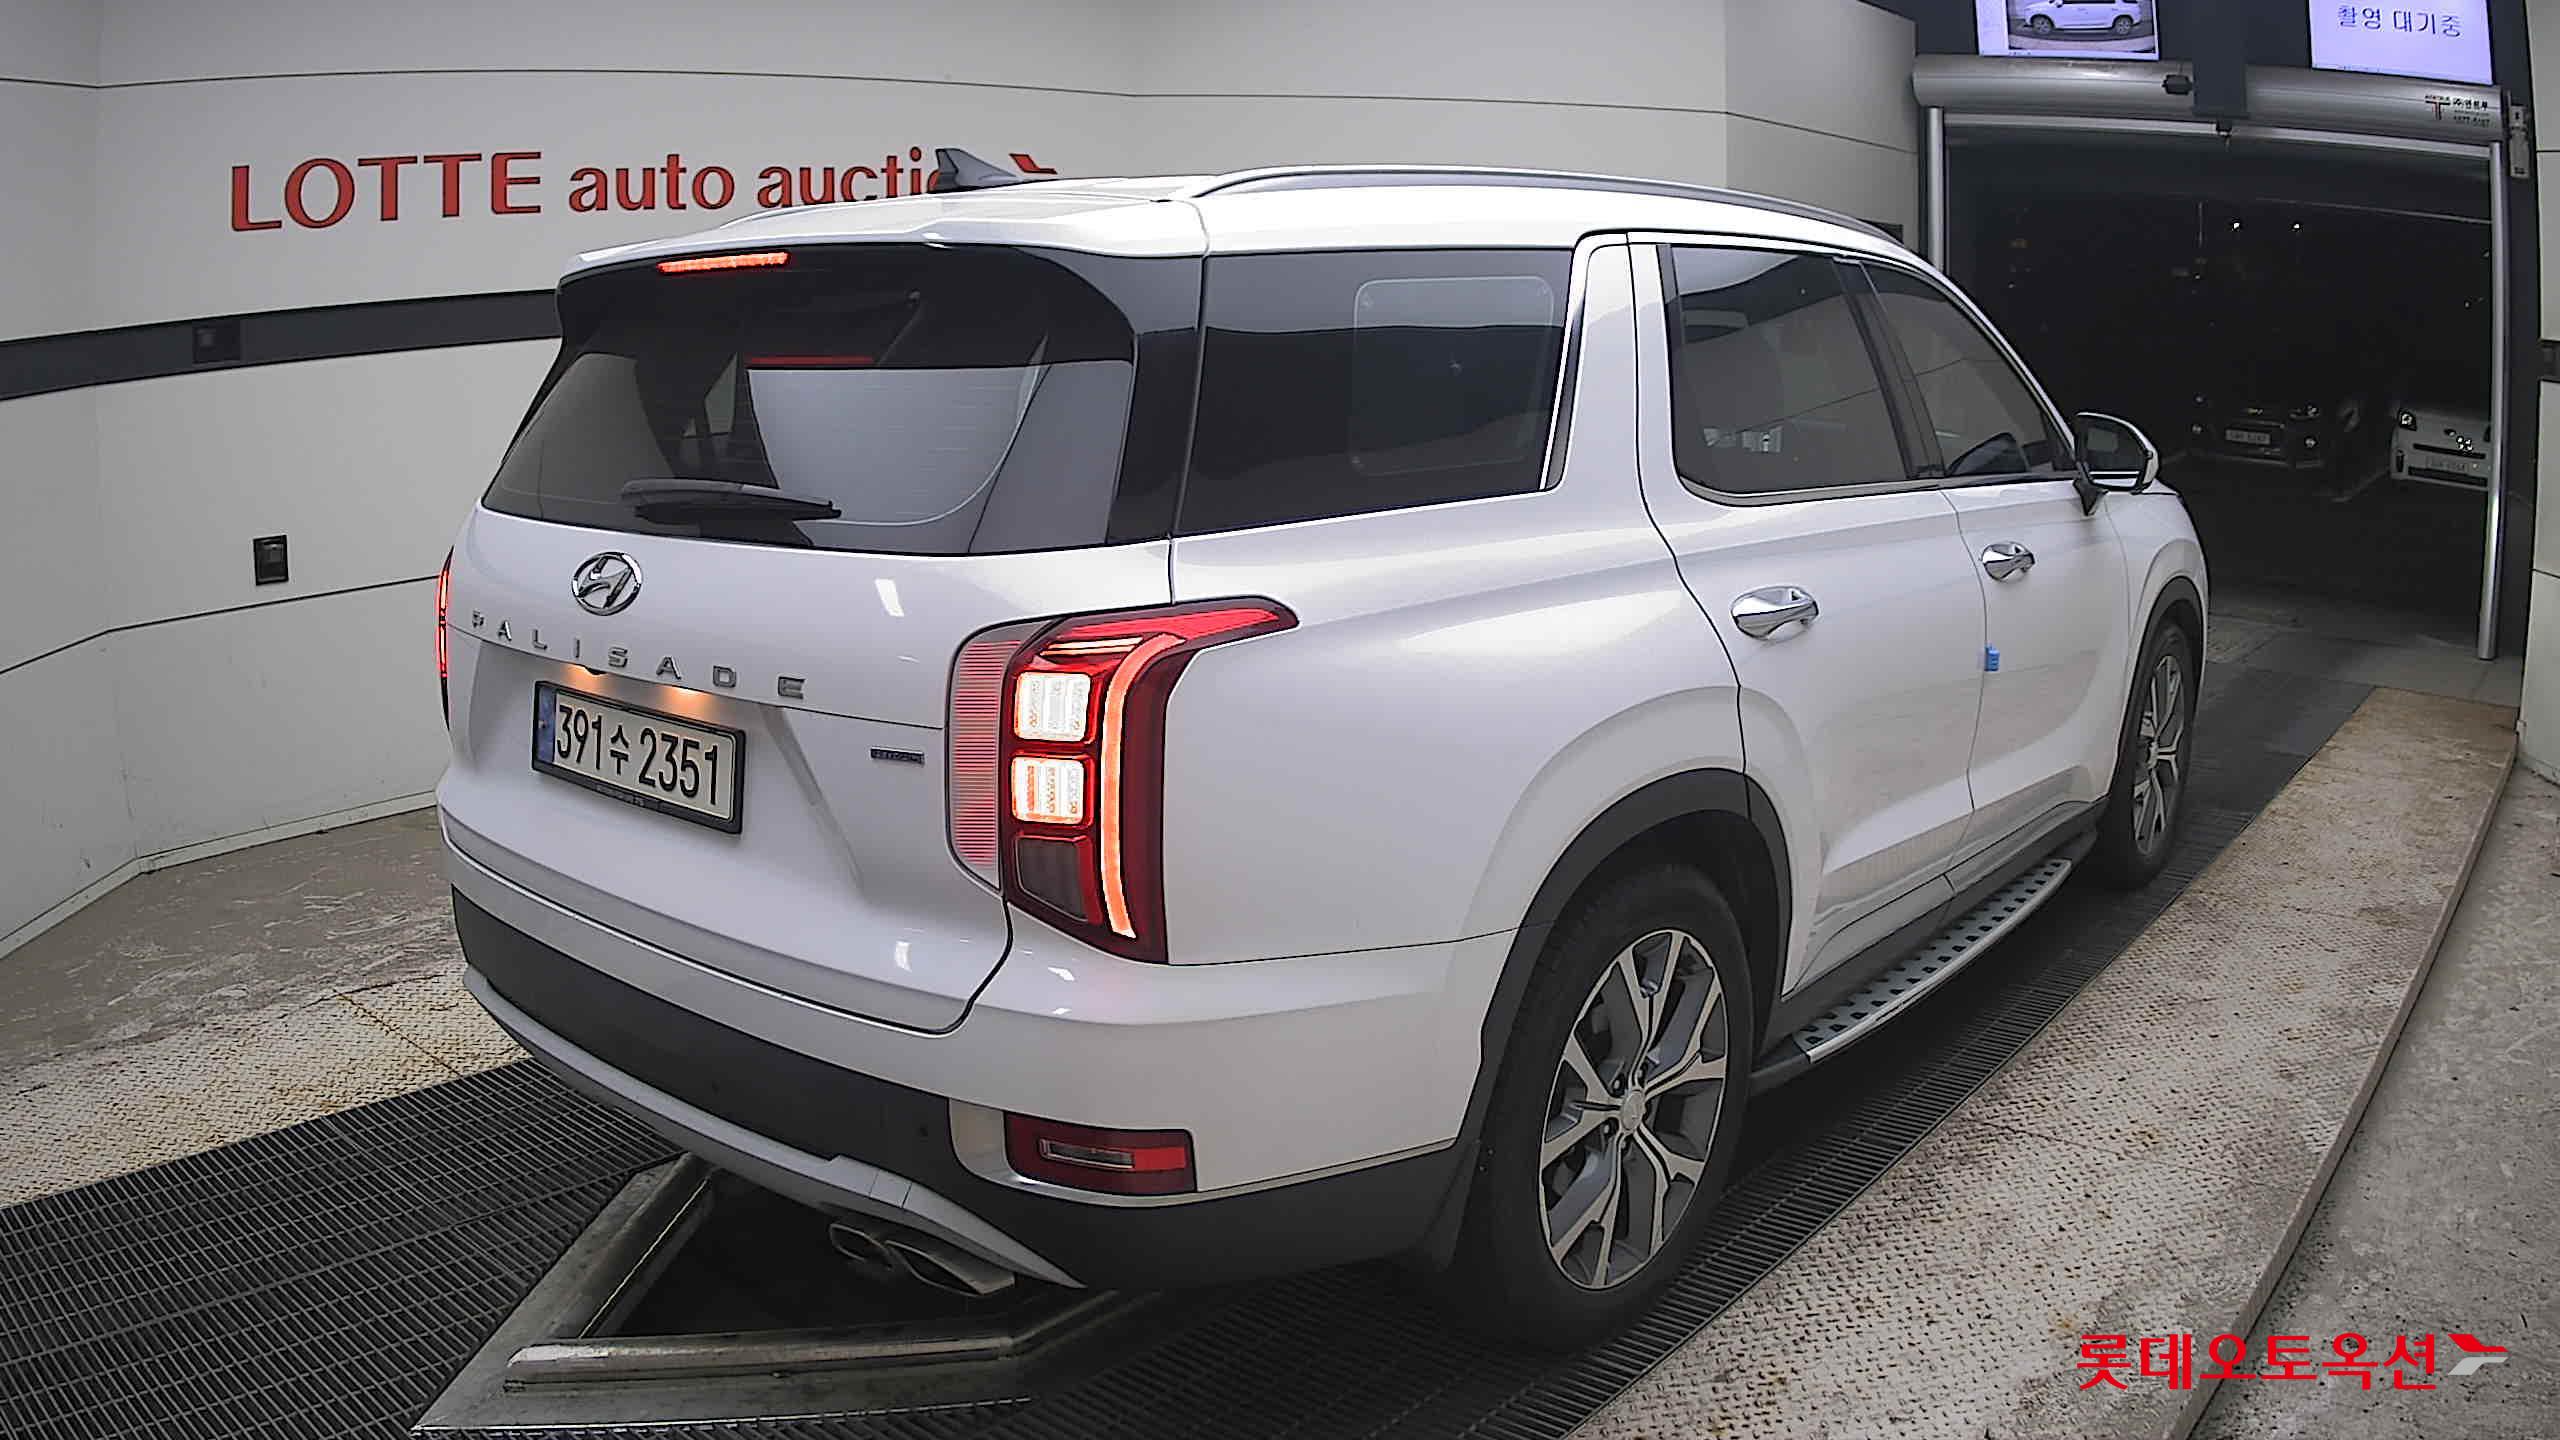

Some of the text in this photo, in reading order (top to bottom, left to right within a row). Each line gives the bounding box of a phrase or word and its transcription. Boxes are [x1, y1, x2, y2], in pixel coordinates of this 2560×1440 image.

[2339, 5, 2461, 38] 촬영 대기중
[231, 146, 941, 231] LOTTE auto aucti
[471, 610, 806, 700] PALISADE
